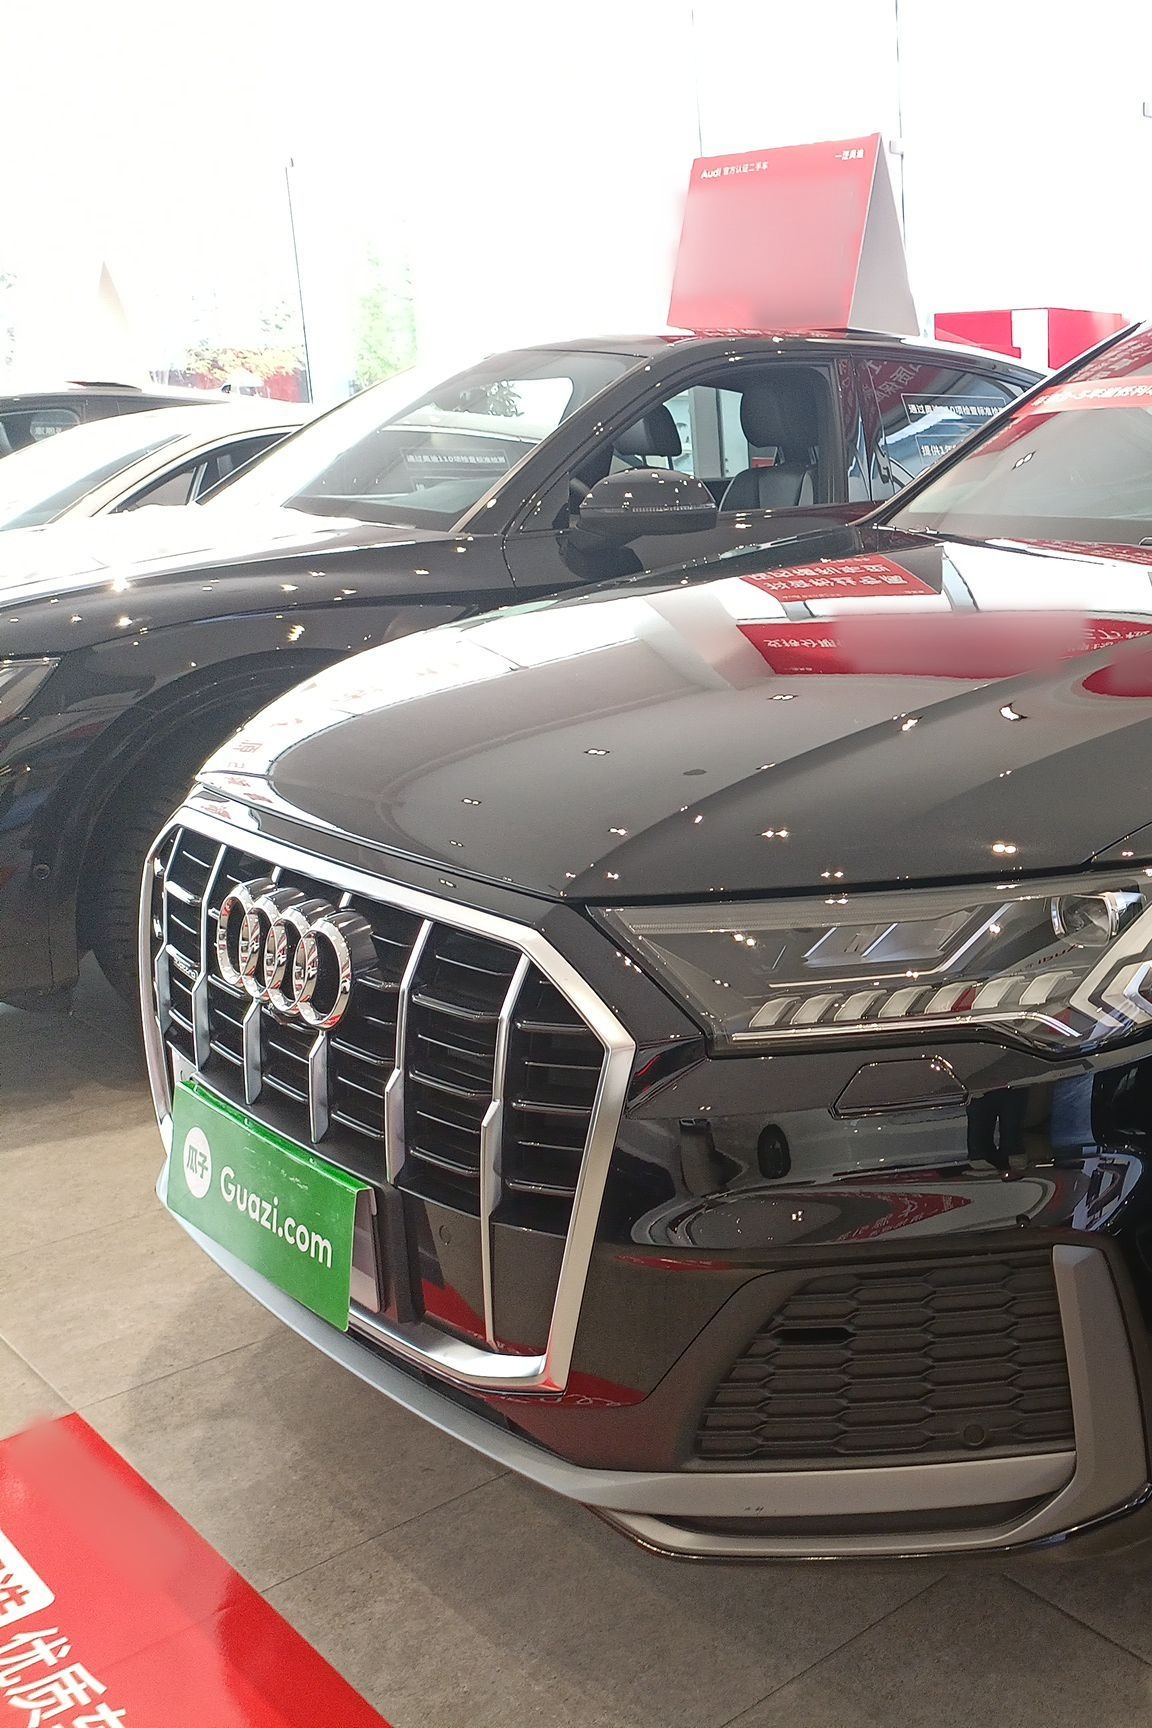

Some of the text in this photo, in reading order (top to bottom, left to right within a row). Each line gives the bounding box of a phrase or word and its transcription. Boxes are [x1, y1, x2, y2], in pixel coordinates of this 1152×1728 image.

[701, 168, 721, 179] Audi
[187, 1144, 209, 1179] 瓜子
[220, 1166, 333, 1268] Guazi.com
